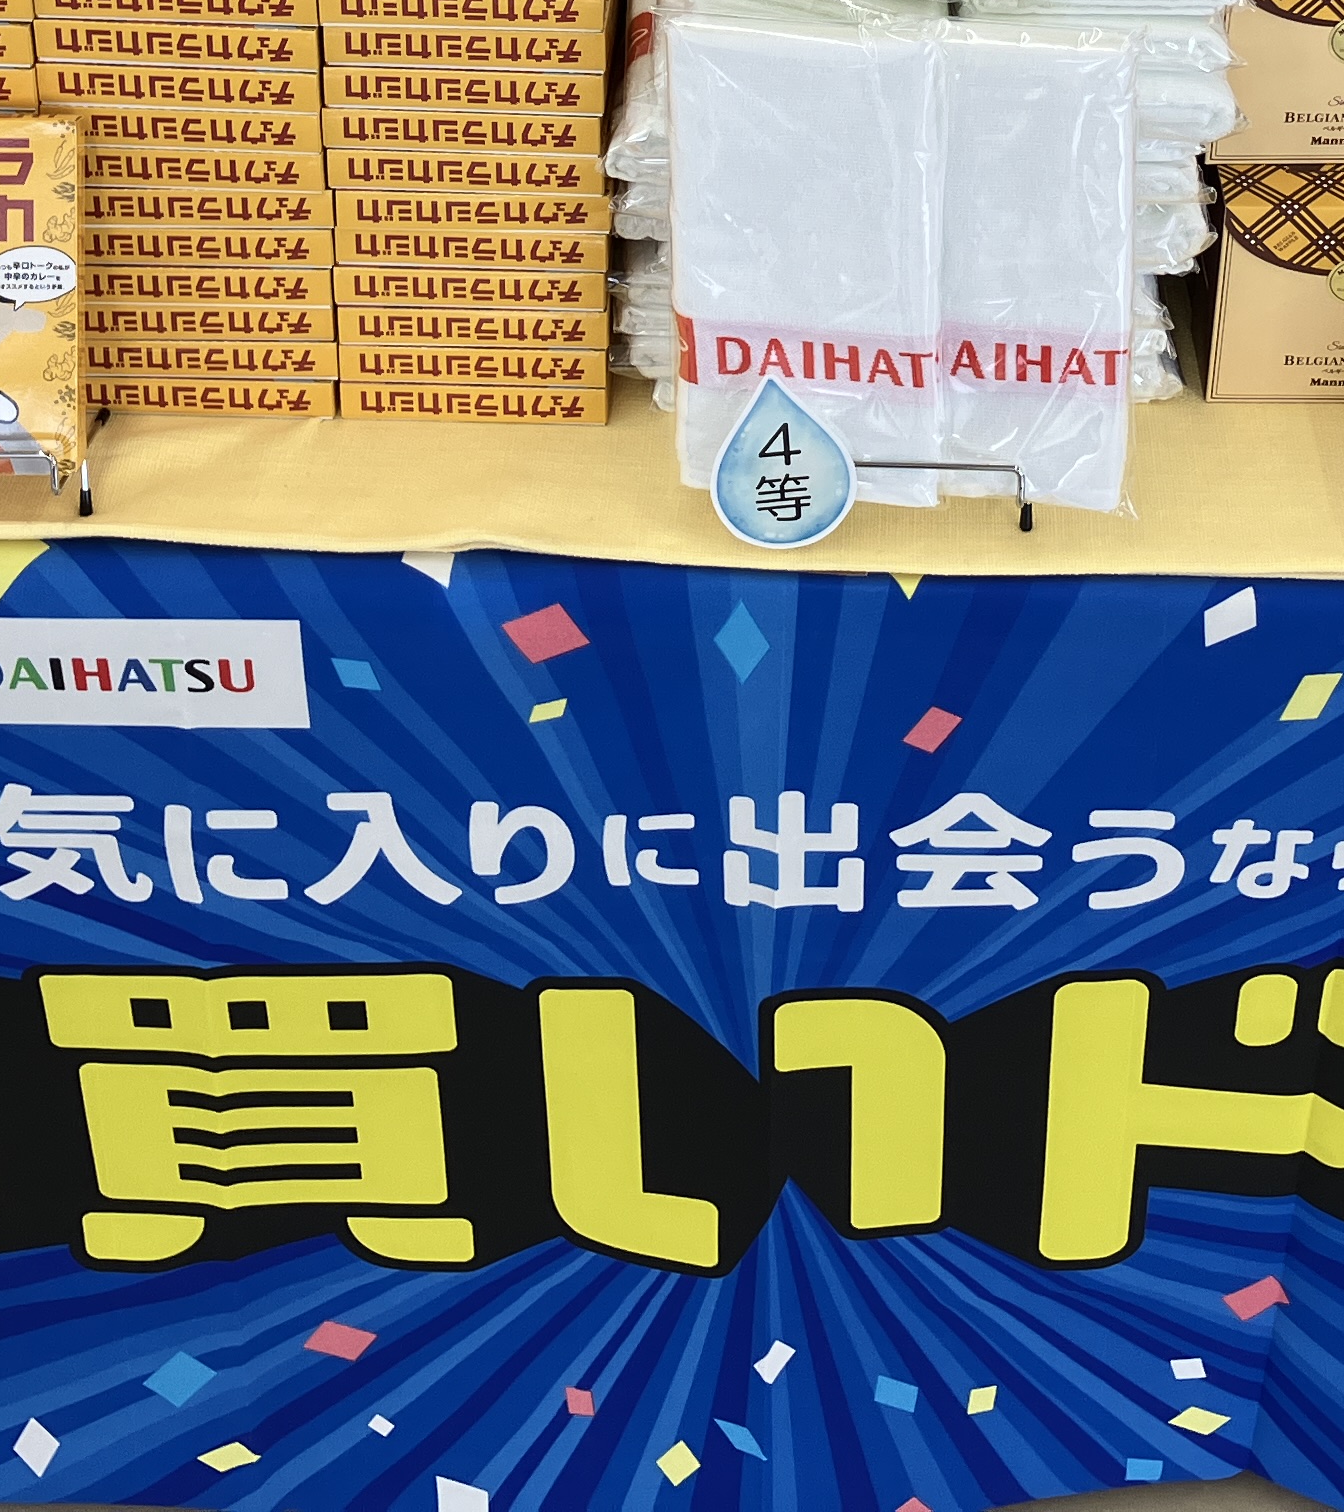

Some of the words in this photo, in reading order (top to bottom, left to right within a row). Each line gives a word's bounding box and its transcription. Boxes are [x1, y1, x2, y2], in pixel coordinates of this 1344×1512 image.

[58, 72, 294, 105] チュウカラシカジカ
[345, 76, 580, 106] チュウカラシカジカ
[348, 158, 580, 187] チュウカラシカジカ
[356, 234, 584, 263] チュウカラシカジカ
[359, 316, 585, 341] チュウカラシカジカ
[88, 347, 315, 371] チュウカラシカジカ
[86, 384, 310, 411] チュウカラシカジカ
[361, 392, 584, 417] チュウカラシカジカ
[755, 422, 812, 522] 4等
